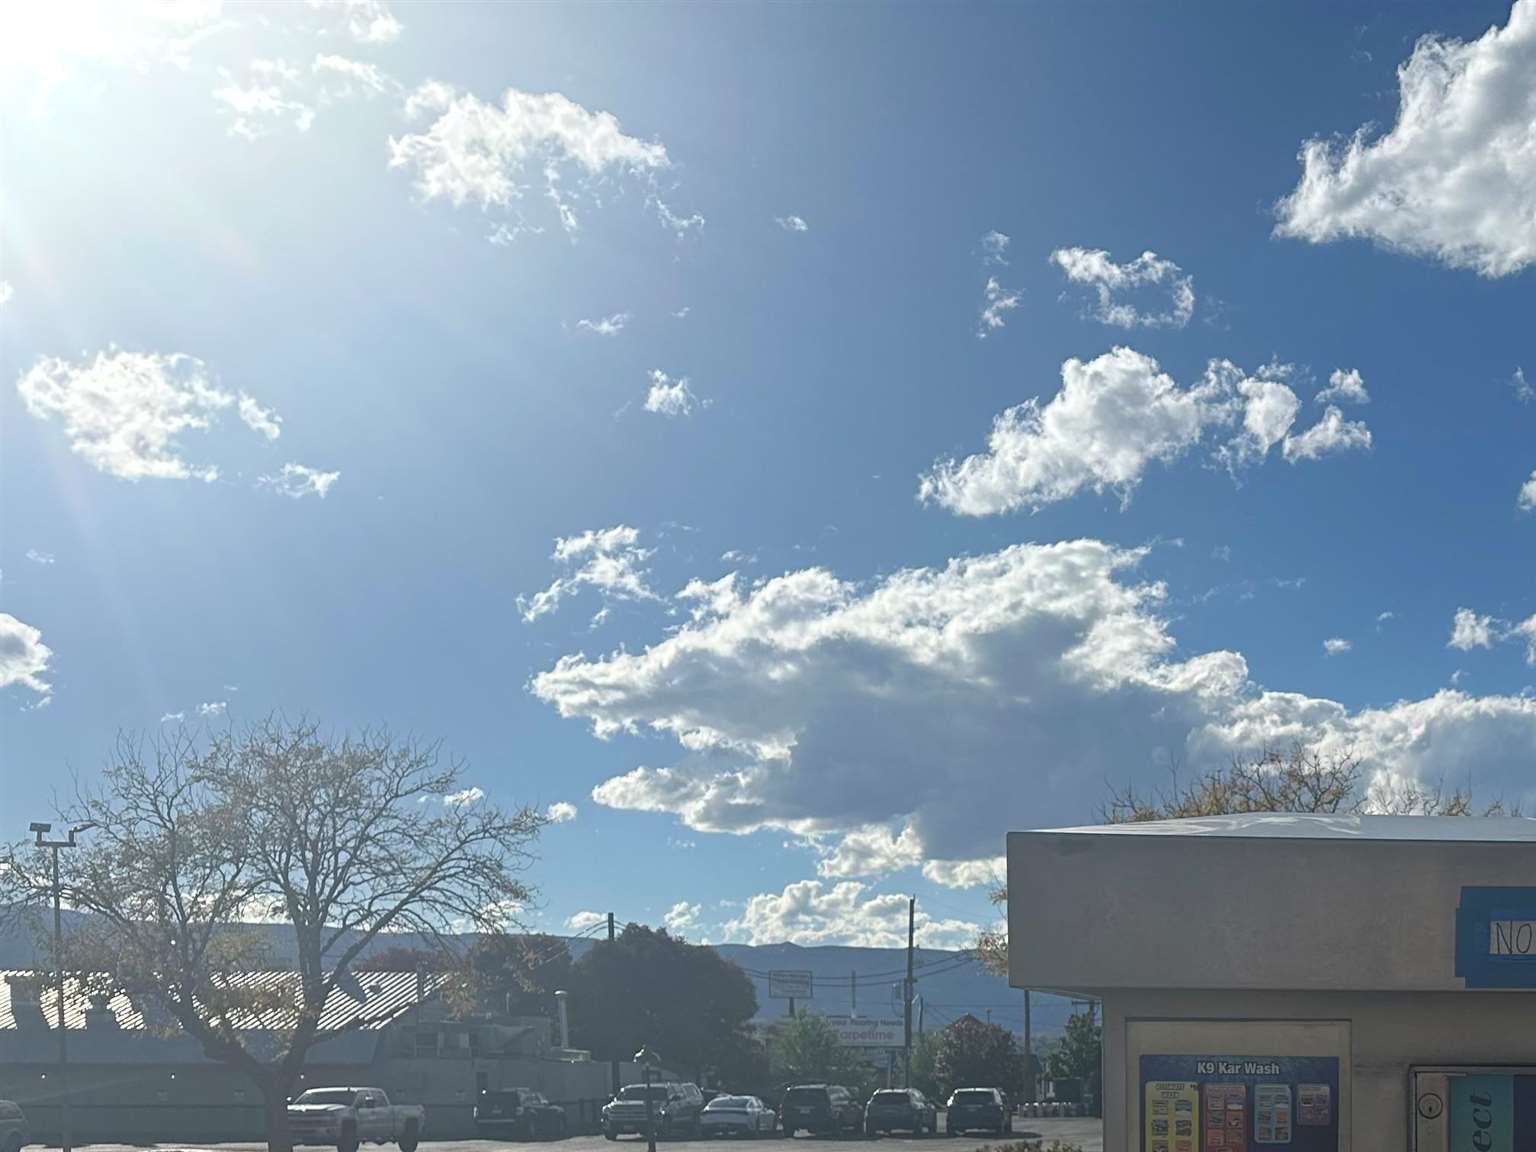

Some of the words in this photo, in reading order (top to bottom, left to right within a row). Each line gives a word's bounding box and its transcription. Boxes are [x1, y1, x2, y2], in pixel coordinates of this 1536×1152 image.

[1495, 922, 1533, 956] NO
[1196, 1061, 1216, 1076] K9
[1218, 1061, 1241, 1076] Kar
[1244, 1061, 1280, 1076] Wash
